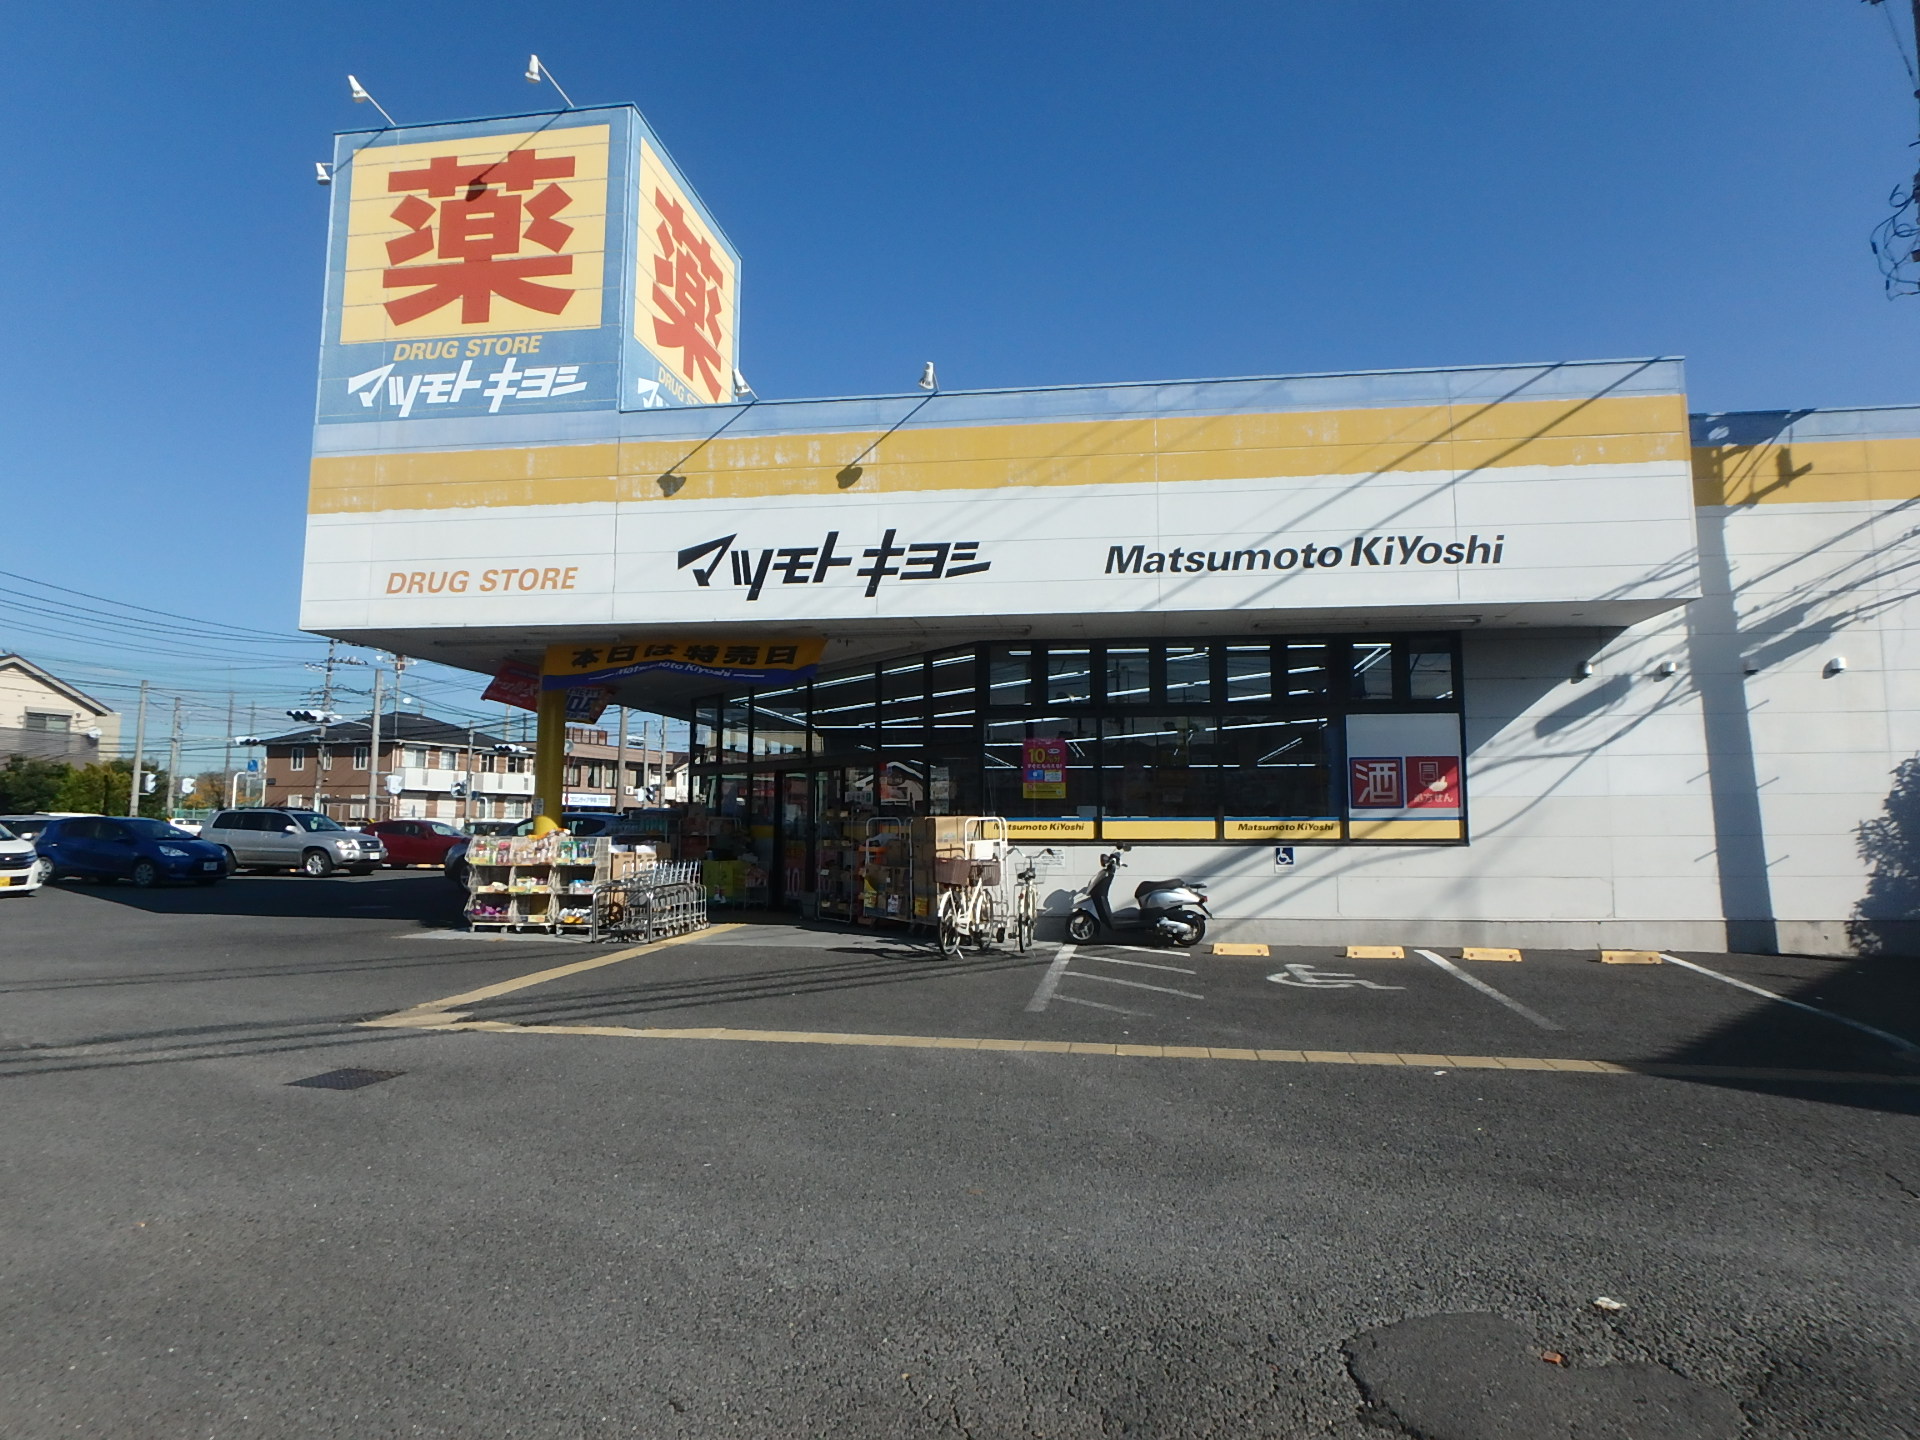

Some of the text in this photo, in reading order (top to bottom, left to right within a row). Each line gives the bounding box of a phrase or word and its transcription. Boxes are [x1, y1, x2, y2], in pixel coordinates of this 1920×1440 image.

[383, 149, 576, 326] 薬
[653, 186, 724, 404] 薬
[393, 335, 543, 361] DRUG STORE
[348, 357, 588, 417] マツモトキヨシ
[658, 366, 685, 401] DRUG
[678, 529, 991, 600] マツモトキヨシ
[1105, 543, 1343, 574] Matsumoto
[386, 567, 579, 595] DRUG STORE
[571, 644, 799, 669] 本日は特売日
[1355, 762, 1397, 803] 酒
[994, 823, 1048, 831] Mtsumoto
[1237, 823, 1296, 831] Matsumoto
